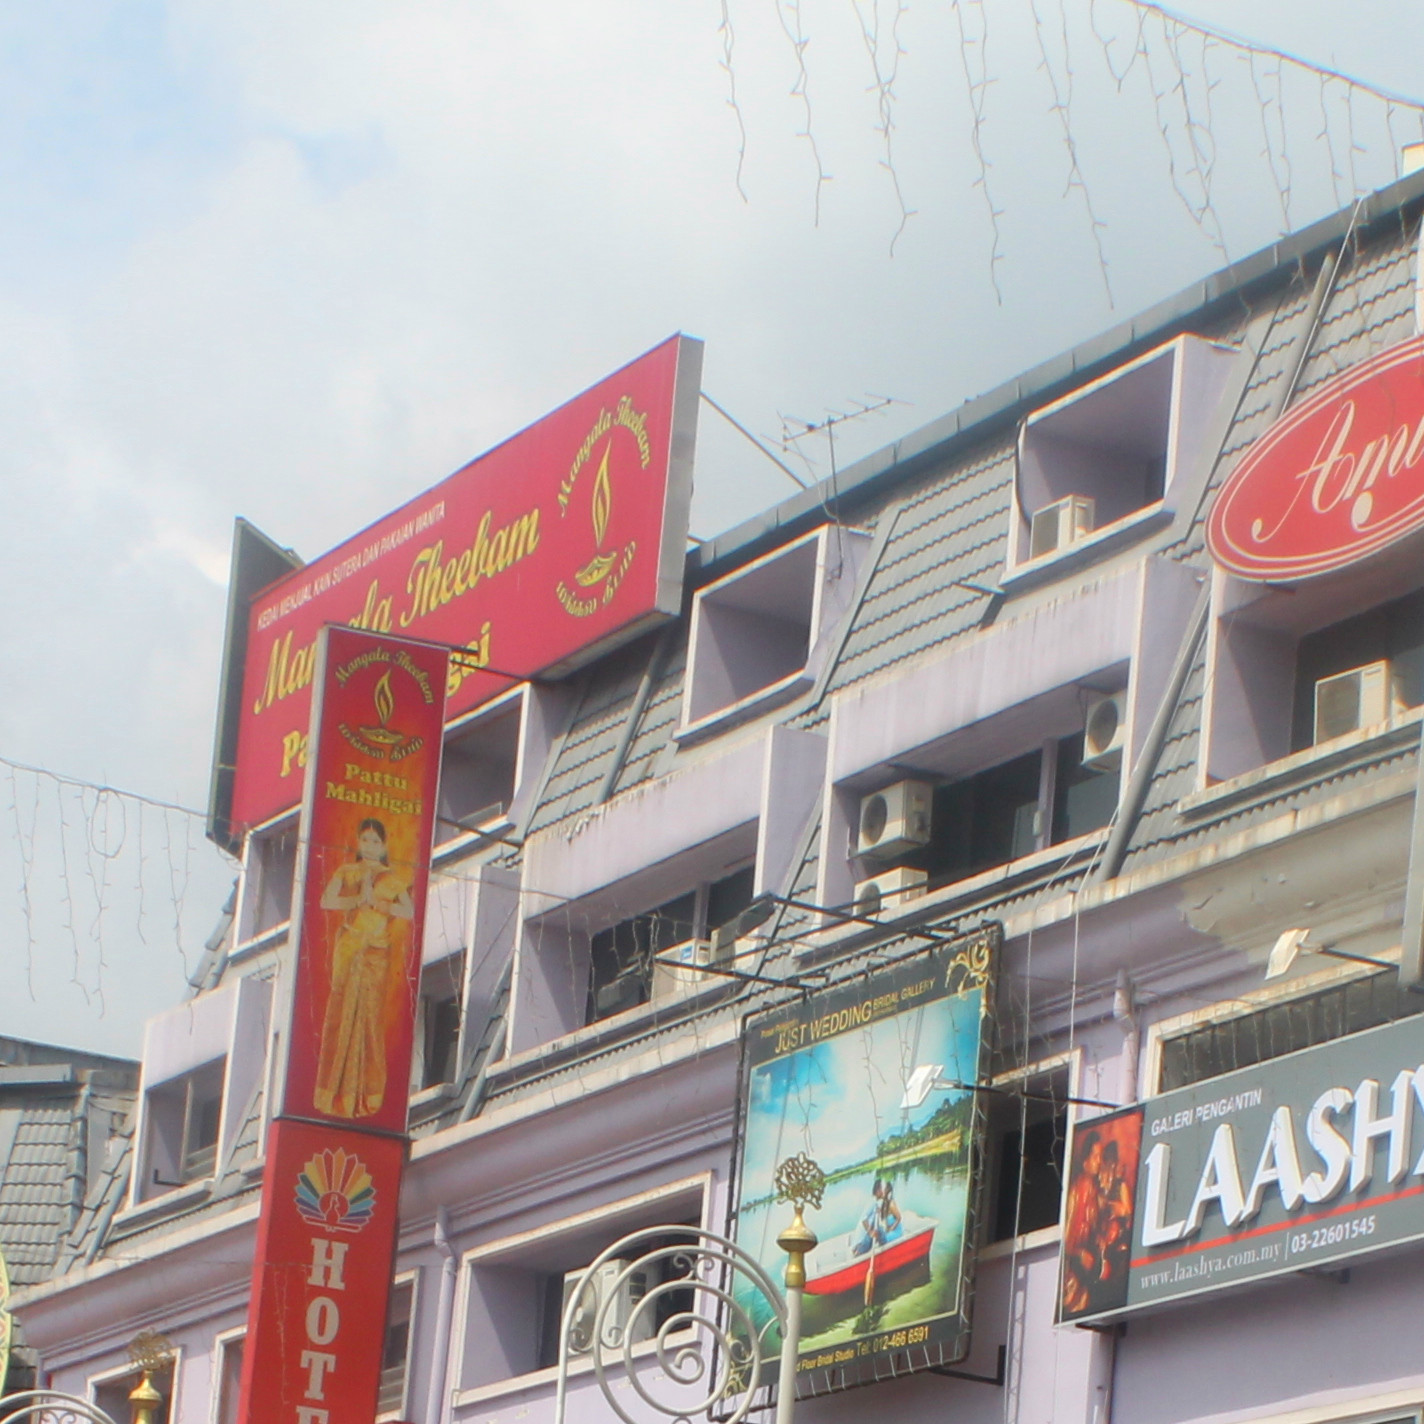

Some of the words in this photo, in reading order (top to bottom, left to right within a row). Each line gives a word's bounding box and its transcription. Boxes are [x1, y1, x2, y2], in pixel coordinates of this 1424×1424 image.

[400, 508, 541, 629] Theebam
[325, 780, 422, 816] Mahligai
[344, 763, 408, 791] Pattu
[900, 977, 936, 1000] GALLERY
[775, 1024, 807, 1054] JUST
[810, 1001, 872, 1041] WEDDING
[1151, 1109, 1192, 1138] GALERI
[1195, 1087, 1263, 1125] PENGANTIN
[1140, 1243, 1283, 1291] www.laashya.com.my
[1291, 1218, 1377, 1255] 03-22601545
